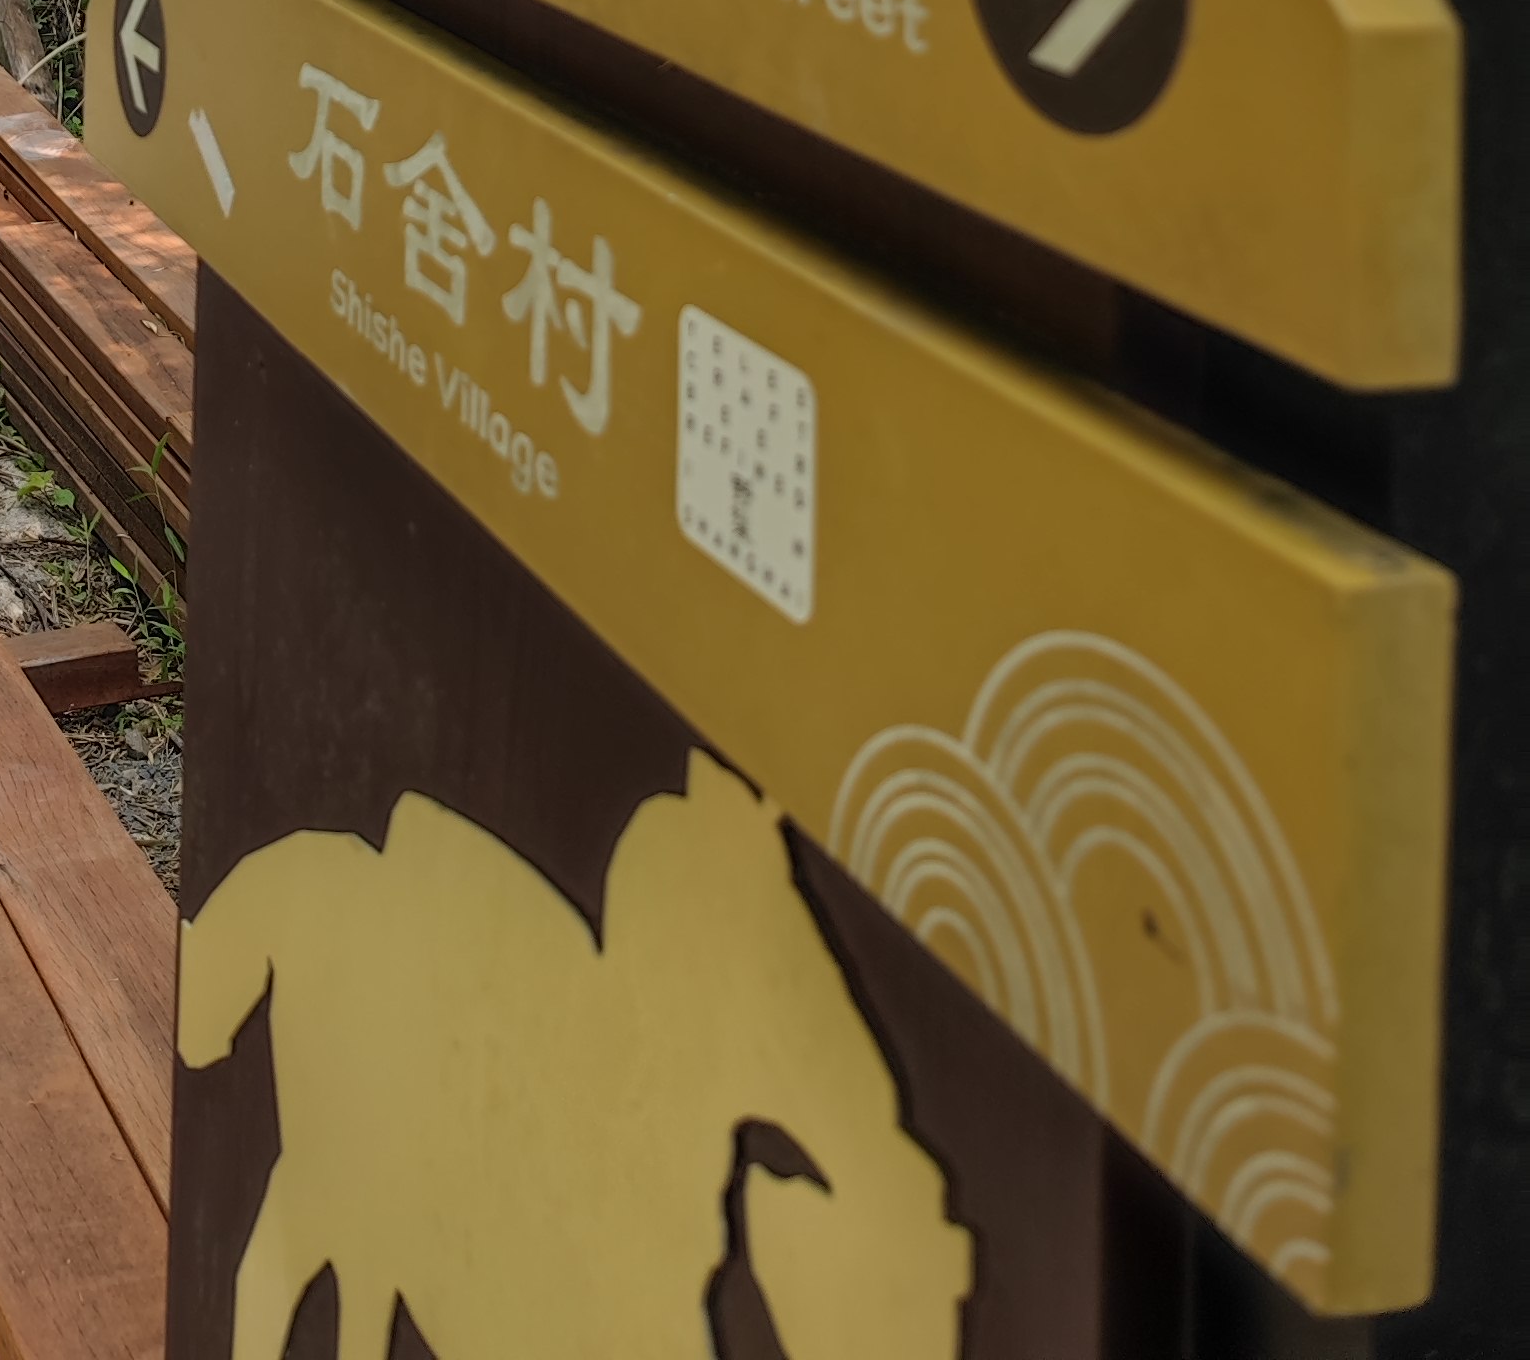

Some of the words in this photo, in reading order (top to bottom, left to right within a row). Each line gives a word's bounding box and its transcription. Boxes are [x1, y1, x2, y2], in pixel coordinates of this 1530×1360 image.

[286, 62, 642, 437] 石舍村
[329, 268, 429, 387] Shishe
[433, 353, 560, 500] Village
